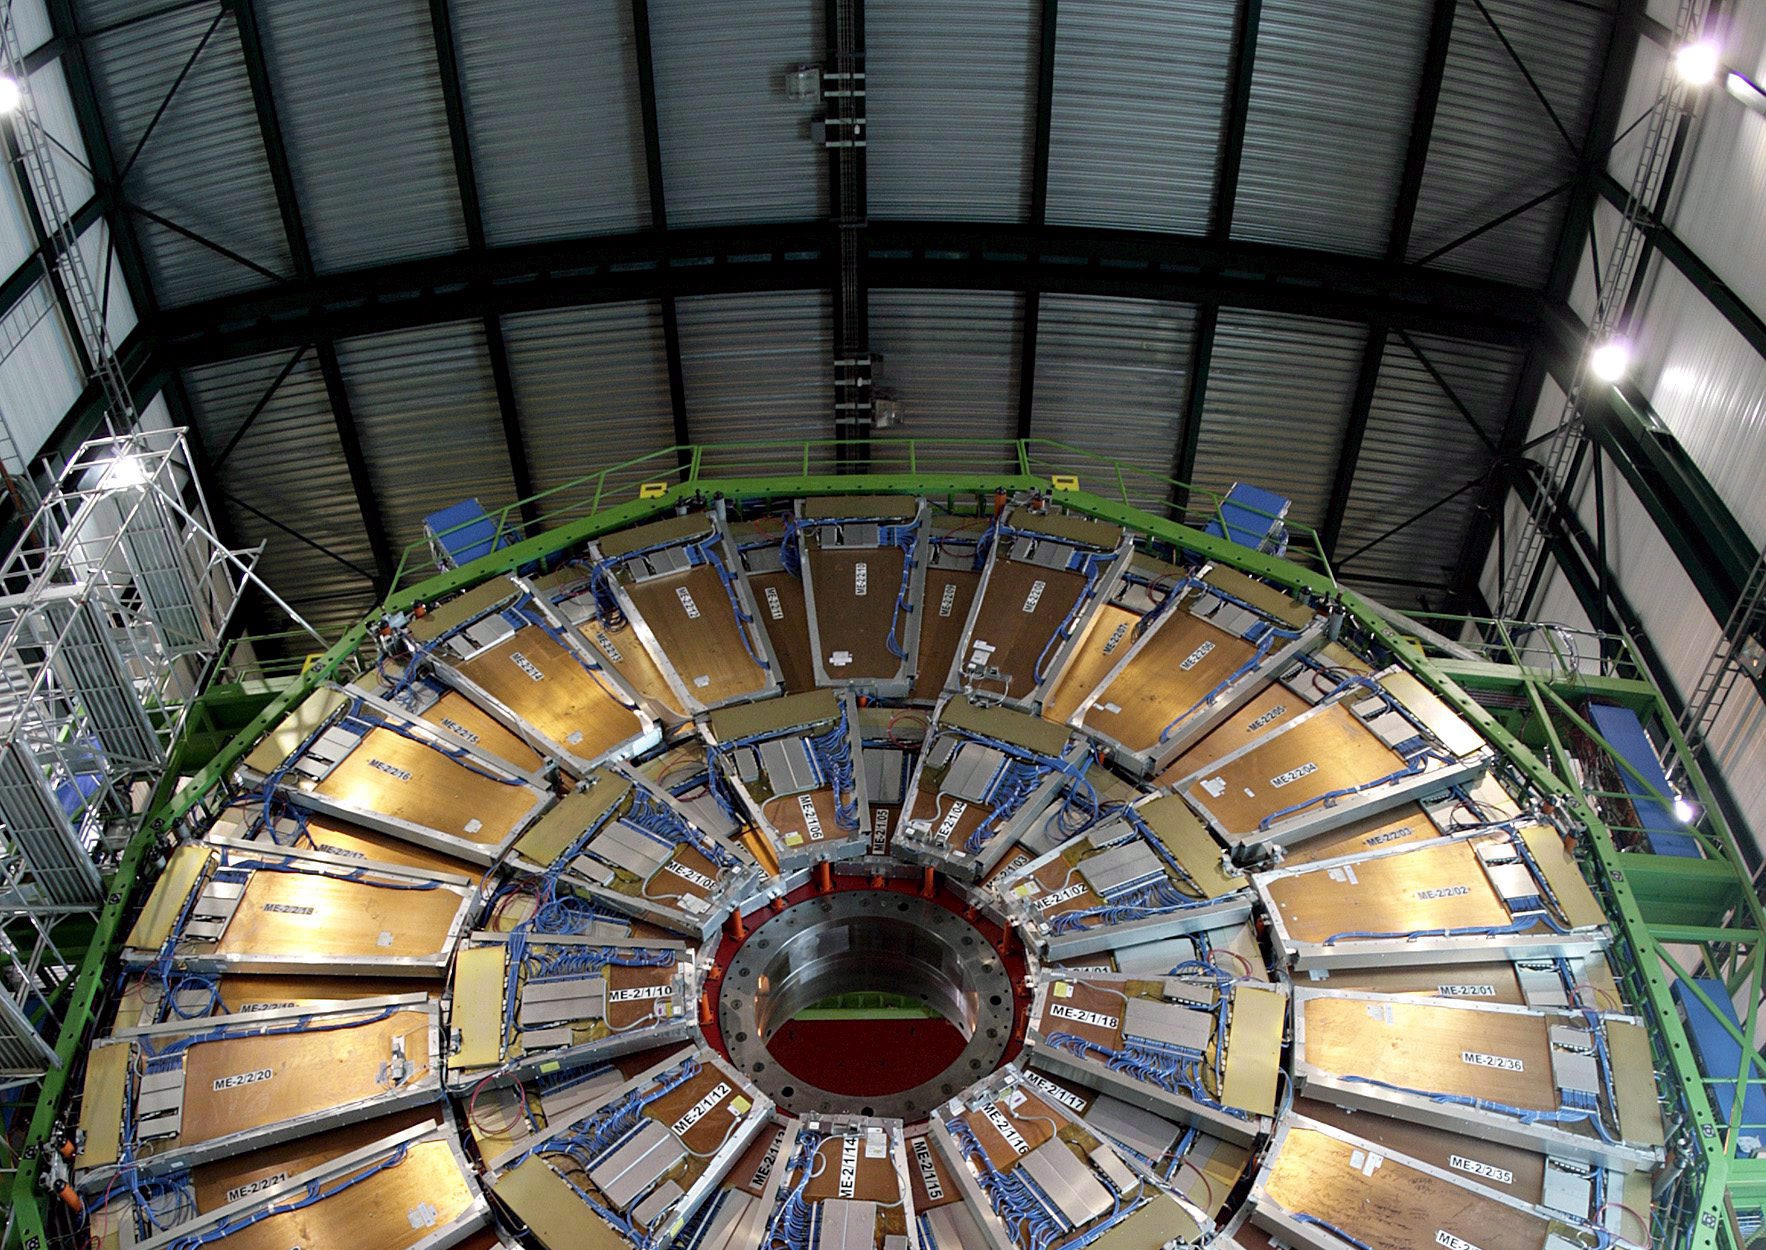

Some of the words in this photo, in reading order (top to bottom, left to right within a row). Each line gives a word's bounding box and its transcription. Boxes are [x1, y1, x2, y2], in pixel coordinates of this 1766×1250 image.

[856, 563, 867, 594] ME-2/2/10
[676, 587, 699, 617] ME-2/2/12
[766, 587, 782, 618] ME-2/2/11
[511, 654, 542, 680] ME-2/2/14
[1181, 641, 1214, 670] ME-2/2/06
[1249, 705, 1286, 731] ME-2/2/05
[443, 719, 478, 744] ME-2/2/15
[369, 759, 410, 781] ME-2/2/16
[1273, 763, 1316, 787] ME-2/2/04
[800, 795, 823, 839] ME-2/1/06
[874, 811, 888, 852] ME-2/1/05
[1366, 828, 1412, 846] ME-2/2/03
[1034, 884, 1088, 910] ME-2/1/02
[1417, 887, 1468, 900] ME-2/2/02
[264, 904, 313, 914] ME-2/2/18
[609, 986, 672, 1000] ME-2/1/10
[1440, 985, 1494, 995] ME-2/2/01
[1052, 1006, 1117, 1027] ME-2/1/18
[1465, 1054, 1522, 1070] ME-2/2/36
[215, 1070, 272, 1090] ME-2/2/20
[1027, 1074, 1083, 1108] ME-2/1/17
[674, 1086, 729, 1133] ME-2/1/12
[983, 1103, 1030, 1154] ME-2/1/16
[841, 1138, 856, 1198] ME-2/1/14
[915, 1141, 942, 1199] ME-2/1/15
[1452, 1157, 1511, 1181] ME-2/2/35
[229, 1174, 286, 1199] ME-2/2/21
